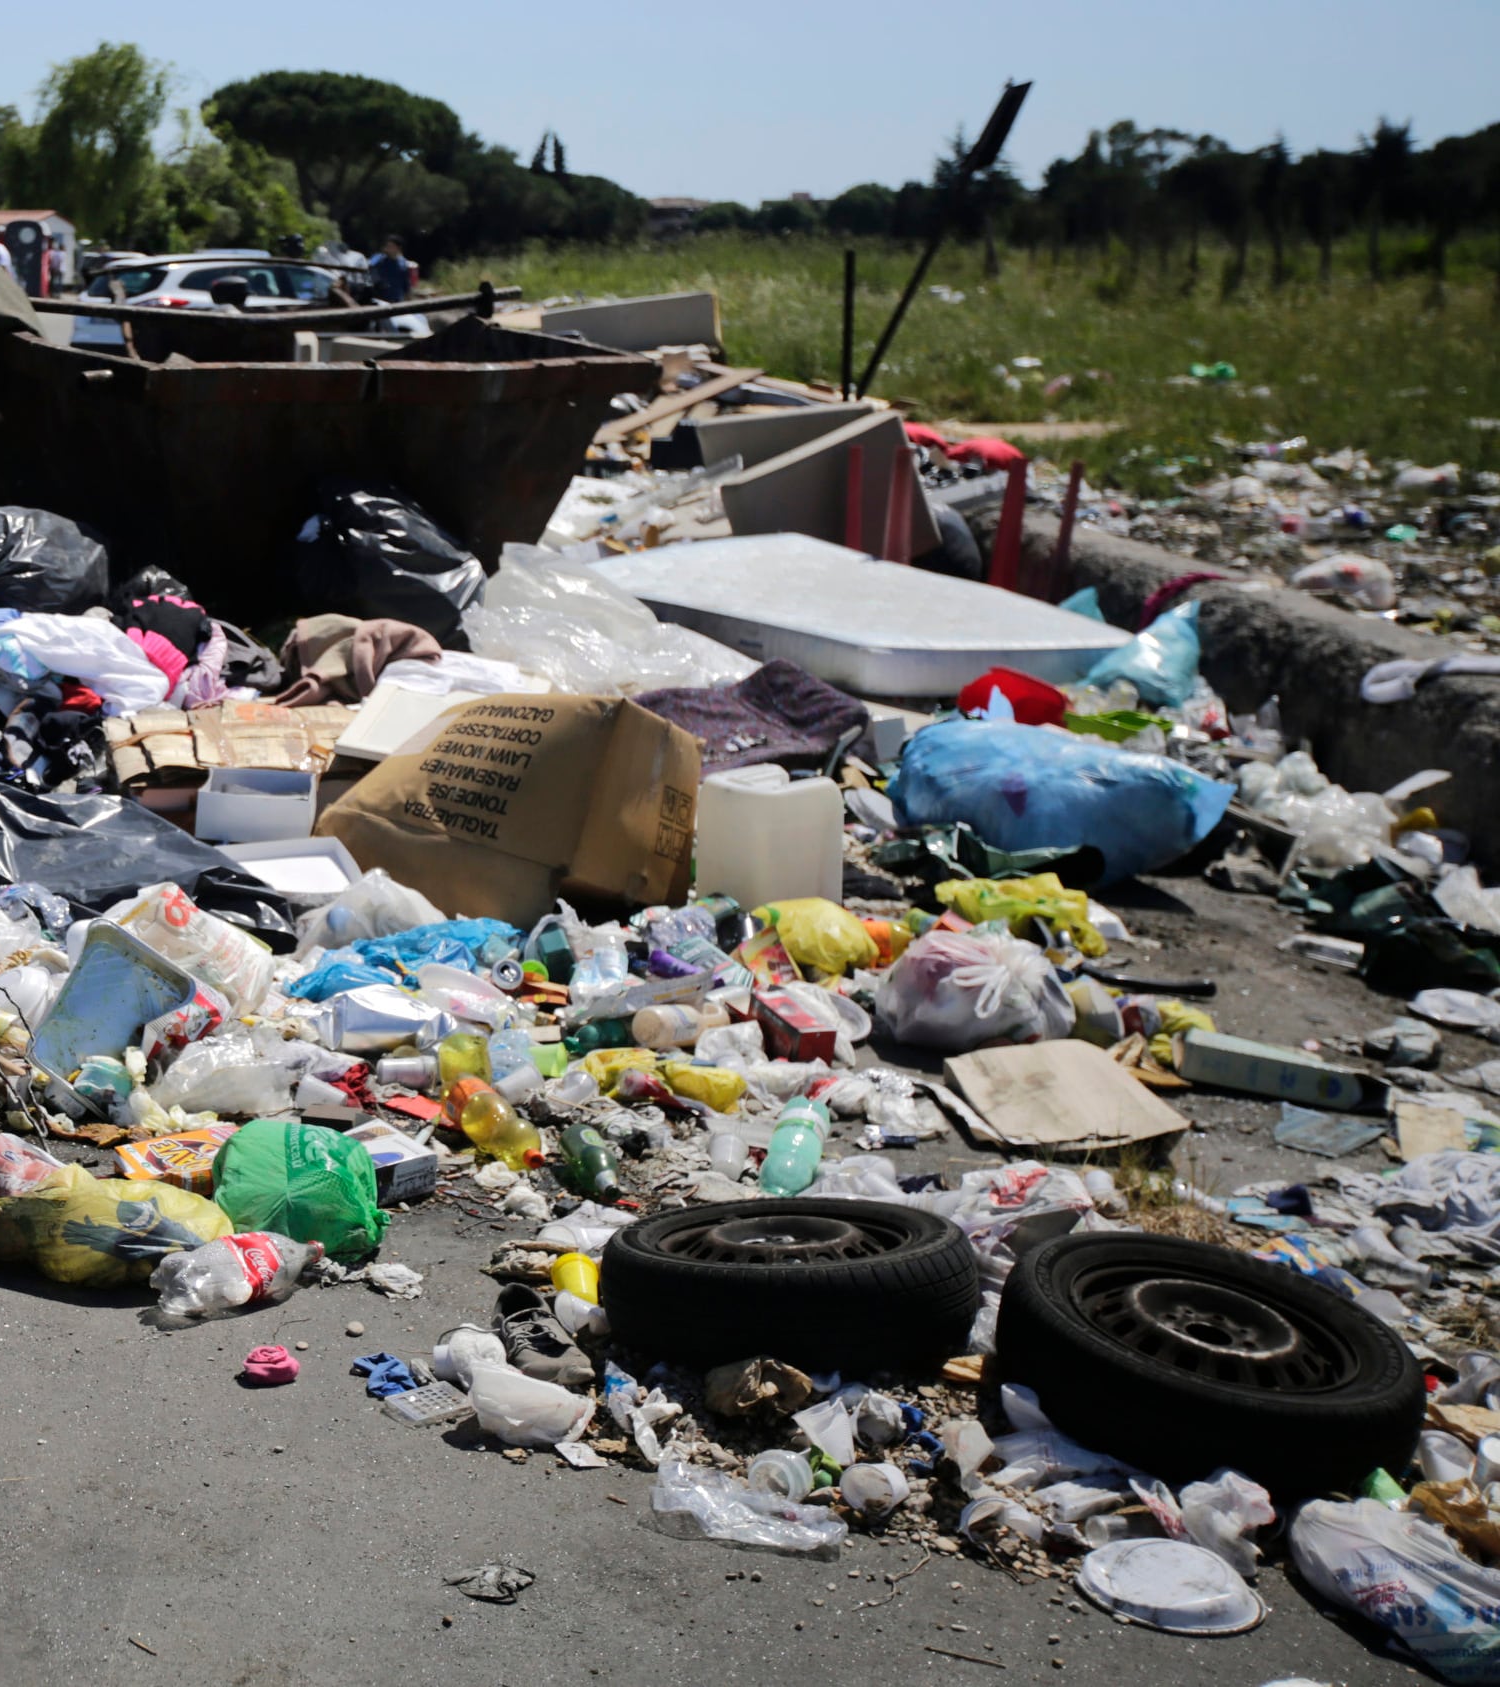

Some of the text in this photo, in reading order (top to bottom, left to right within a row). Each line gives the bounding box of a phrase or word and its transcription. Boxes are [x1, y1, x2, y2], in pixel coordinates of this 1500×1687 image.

[433, 740, 532, 769] LAWN MOWER
[426, 782, 510, 815] TONDEUSE
[404, 799, 499, 839] TAGLIAERBA
